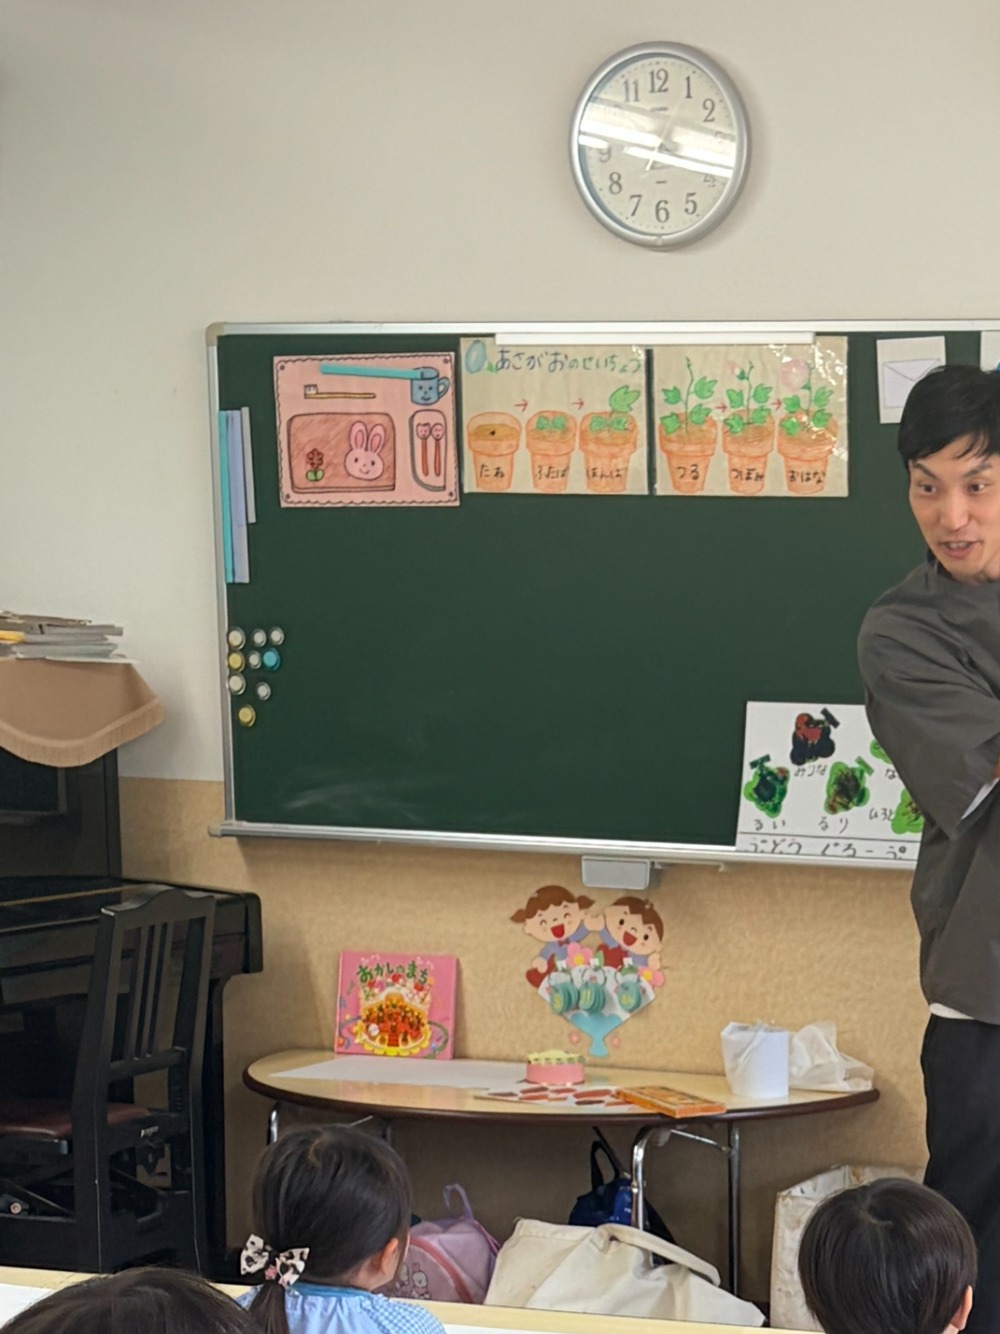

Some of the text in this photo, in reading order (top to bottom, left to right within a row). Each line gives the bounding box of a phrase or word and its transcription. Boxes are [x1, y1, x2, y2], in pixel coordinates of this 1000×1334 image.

[624, 79, 640, 102] 11
[649, 68, 669, 93] 12
[685, 75, 693, 99] 1
[702, 98, 715, 122] 2
[608, 171, 623, 195] 8
[629, 194, 643, 217] 7
[655, 200, 670, 223] 6
[684, 192, 698, 215] 5
